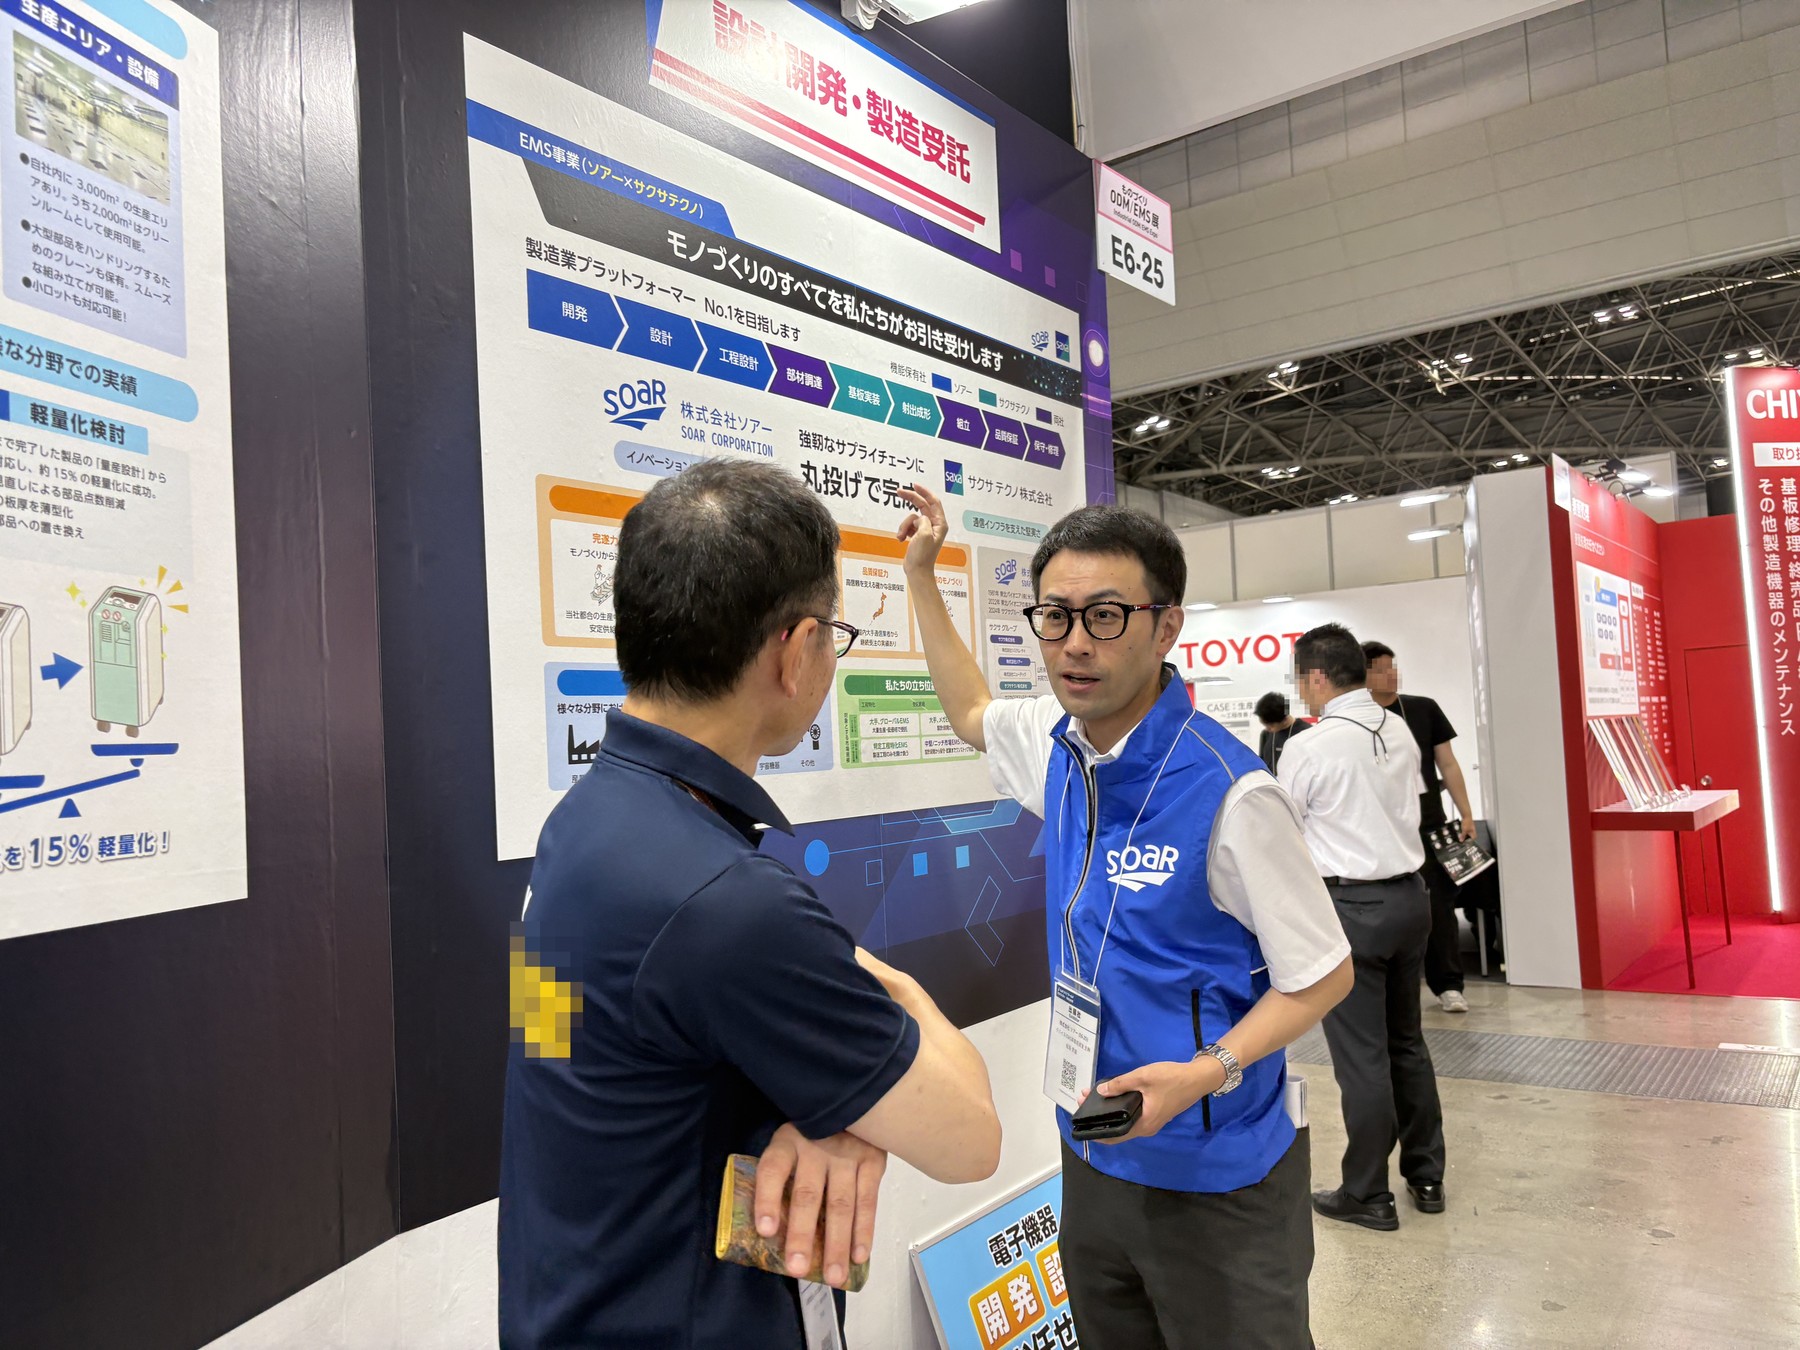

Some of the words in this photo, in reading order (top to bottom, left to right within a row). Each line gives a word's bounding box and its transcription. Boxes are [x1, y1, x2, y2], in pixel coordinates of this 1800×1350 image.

[20, 0, 160, 91] 生産エリア・設備
[1121, 184, 1148, 206] ものづくり
[1110, 189, 1159, 229] ODM/EMS展
[525, 236, 697, 303] 製造業プラットフォーマー
[1111, 234, 1164, 290] E6-25
[562, 301, 588, 323] 開発
[666, 229, 1004, 372] モノづくりのすべてを私たちがお引き受けします
[650, 327, 673, 347] 設計
[0, 337, 138, 397] な分野での実績
[719, 347, 760, 371] 工程設計
[786, 367, 823, 390] 部材調達
[890, 361, 927, 384] 機能保有社
[848, 385, 881, 406] 基板実装
[954, 382, 973, 396] ソアー
[902, 402, 932, 420] 射出成形
[999, 397, 1031, 416] サクサテクノ
[1746, 388, 1800, 420] CHI
[30, 402, 126, 445] 軽量化検討
[680, 400, 773, 435] 株式会社ソアー
[956, 417, 971, 432] 組立
[681, 425, 706, 444] SOAR
[711, 432, 774, 458] CORPORATION
[626, 450, 688, 472] イノベーショ
[592, 533, 618, 546] 完遂力
[935, 576, 963, 587] のモノづくり
[566, 610, 616, 621] 当社都合の生産
[1758, 478, 1796, 736] その他製造機器のメンテナンス
[30, 832, 90, 864] 15%
[988, 1203, 1059, 1267] 電子機器
[977, 1273, 1039, 1345] 開発
